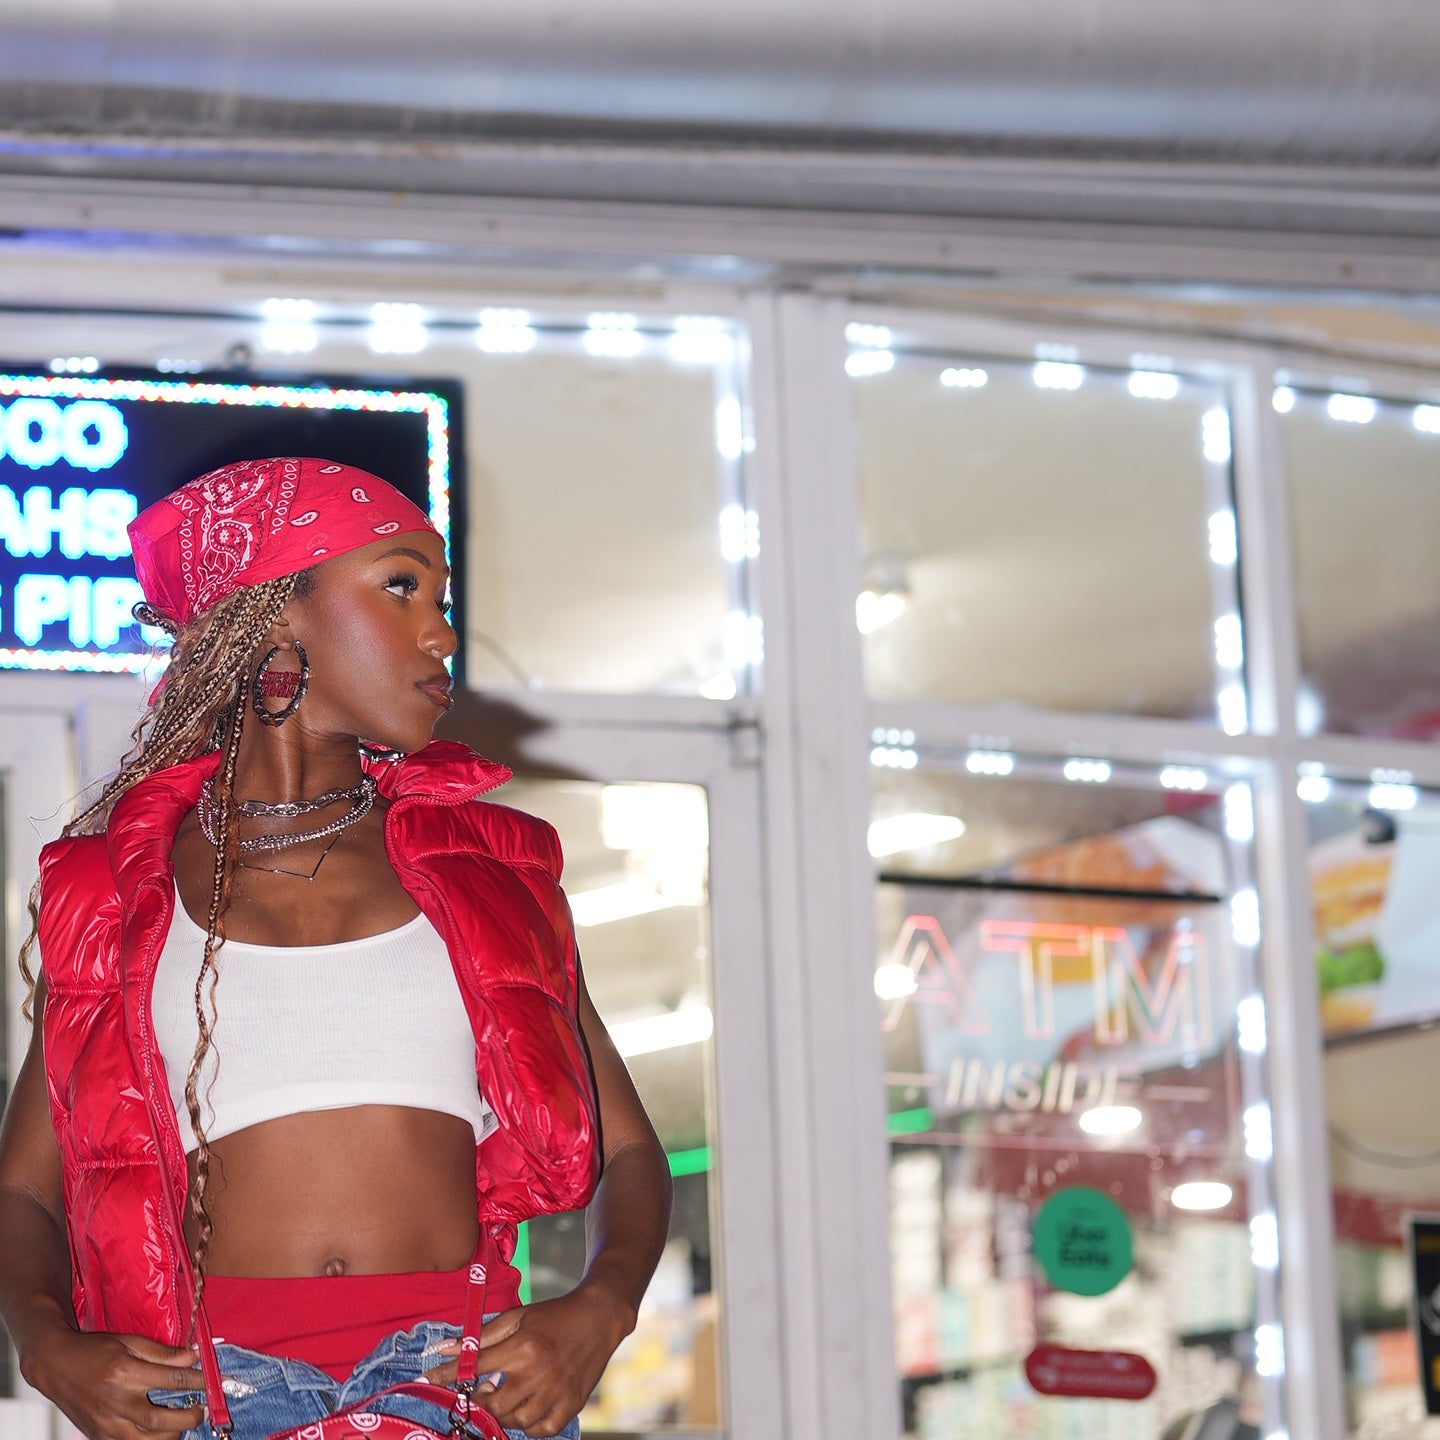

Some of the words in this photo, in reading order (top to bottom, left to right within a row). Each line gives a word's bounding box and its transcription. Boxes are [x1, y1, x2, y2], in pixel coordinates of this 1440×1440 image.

[14, 574, 175, 648] PIP
[879, 914, 1213, 1046] ATM
[945, 1058, 1143, 1114] INSIDE
